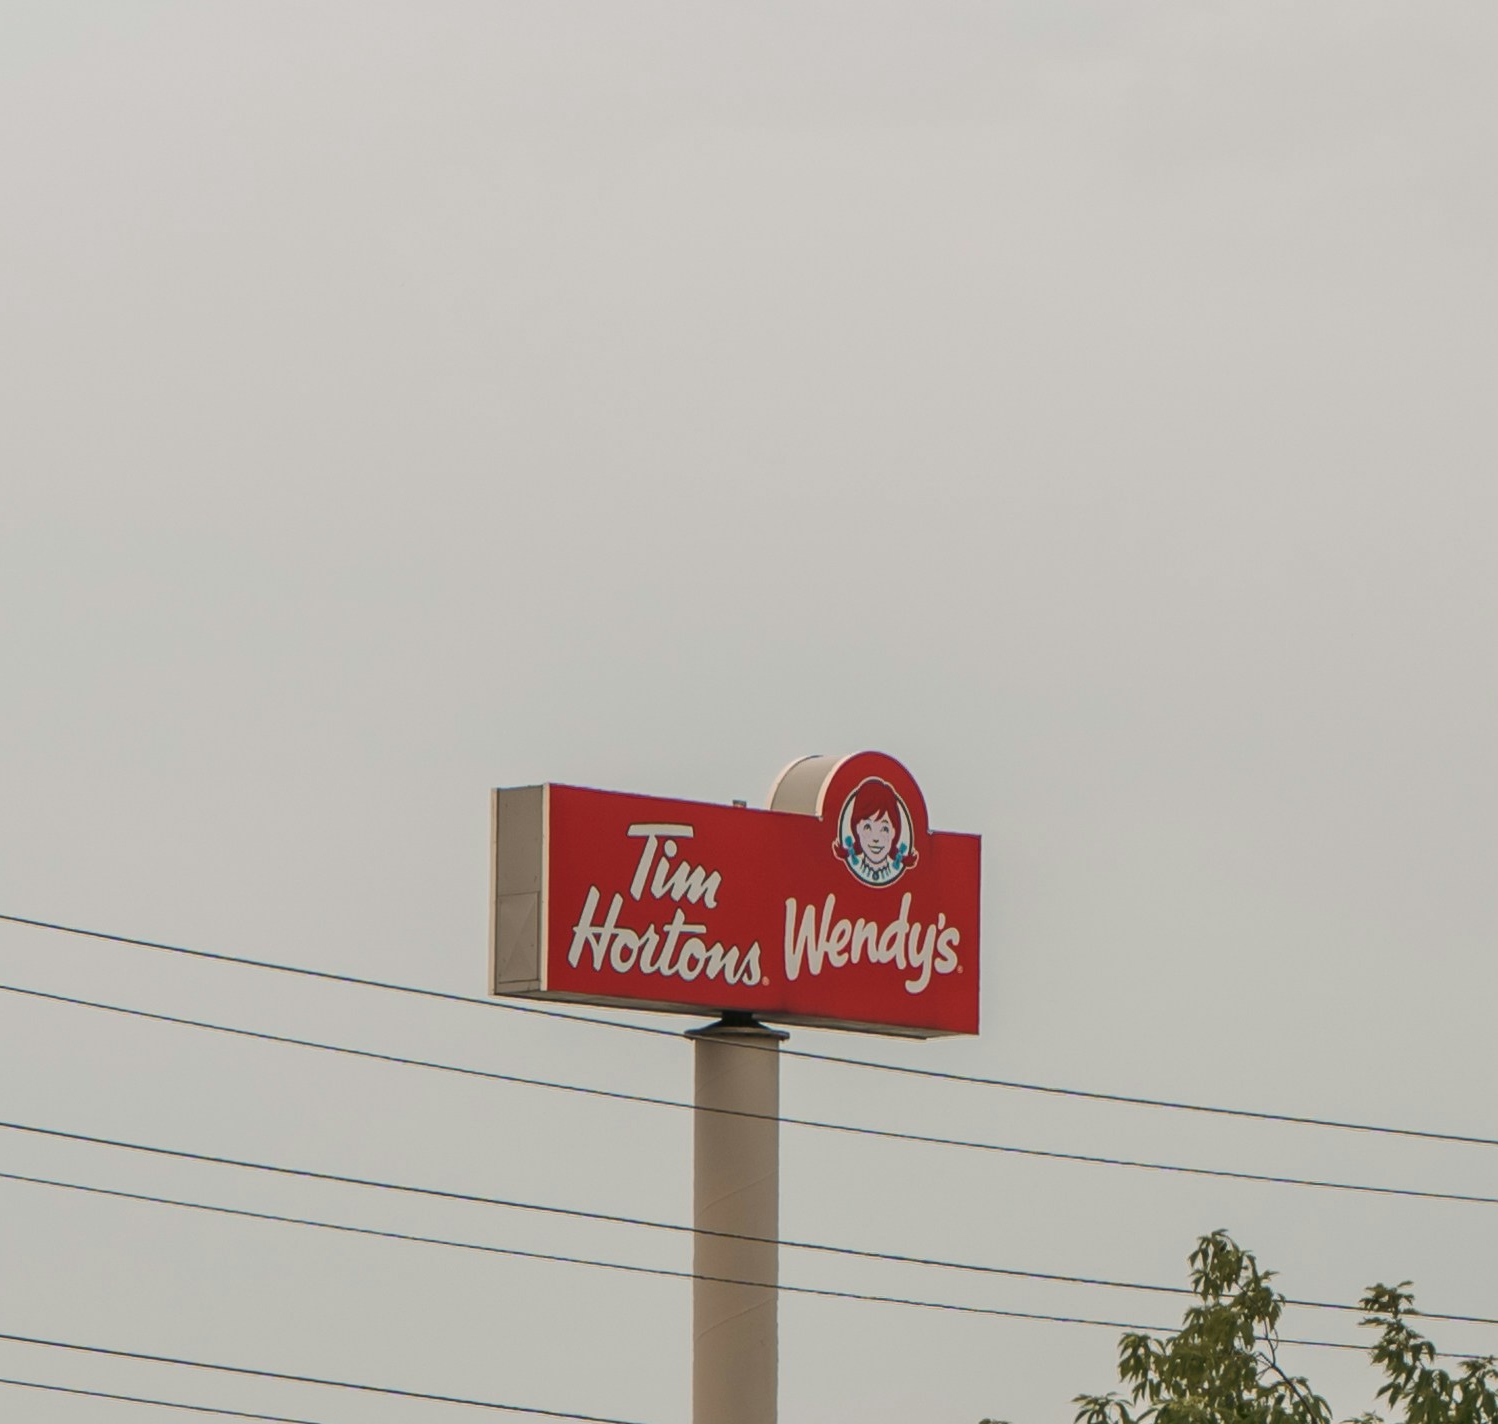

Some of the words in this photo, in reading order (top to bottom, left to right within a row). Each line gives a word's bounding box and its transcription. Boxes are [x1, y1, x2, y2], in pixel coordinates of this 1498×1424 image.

[627, 823, 722, 909] Tim
[567, 884, 762, 986] Hortons
[784, 892, 961, 994] Wendy's
